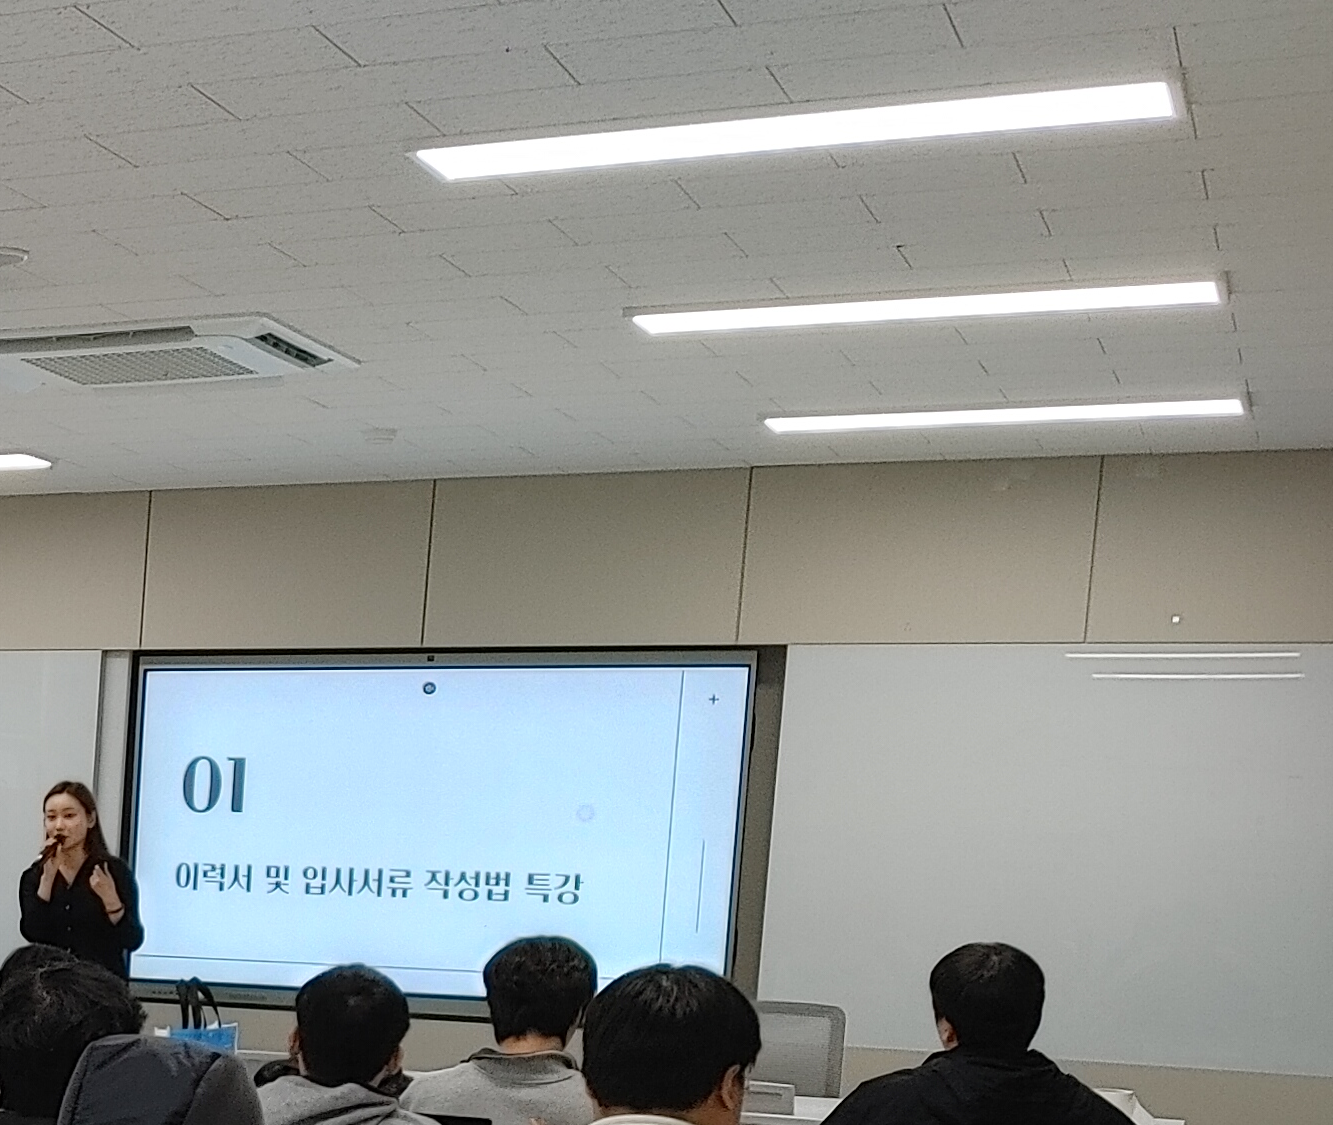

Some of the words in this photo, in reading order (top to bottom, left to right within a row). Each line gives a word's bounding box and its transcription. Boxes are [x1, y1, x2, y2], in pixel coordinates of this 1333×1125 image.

[182, 755, 247, 813] 01
[175, 861, 253, 894] 이력서
[265, 865, 291, 896] 및
[302, 866, 414, 899] 입사서류
[424, 868, 512, 903] 작성법
[524, 872, 584, 906] 특강
